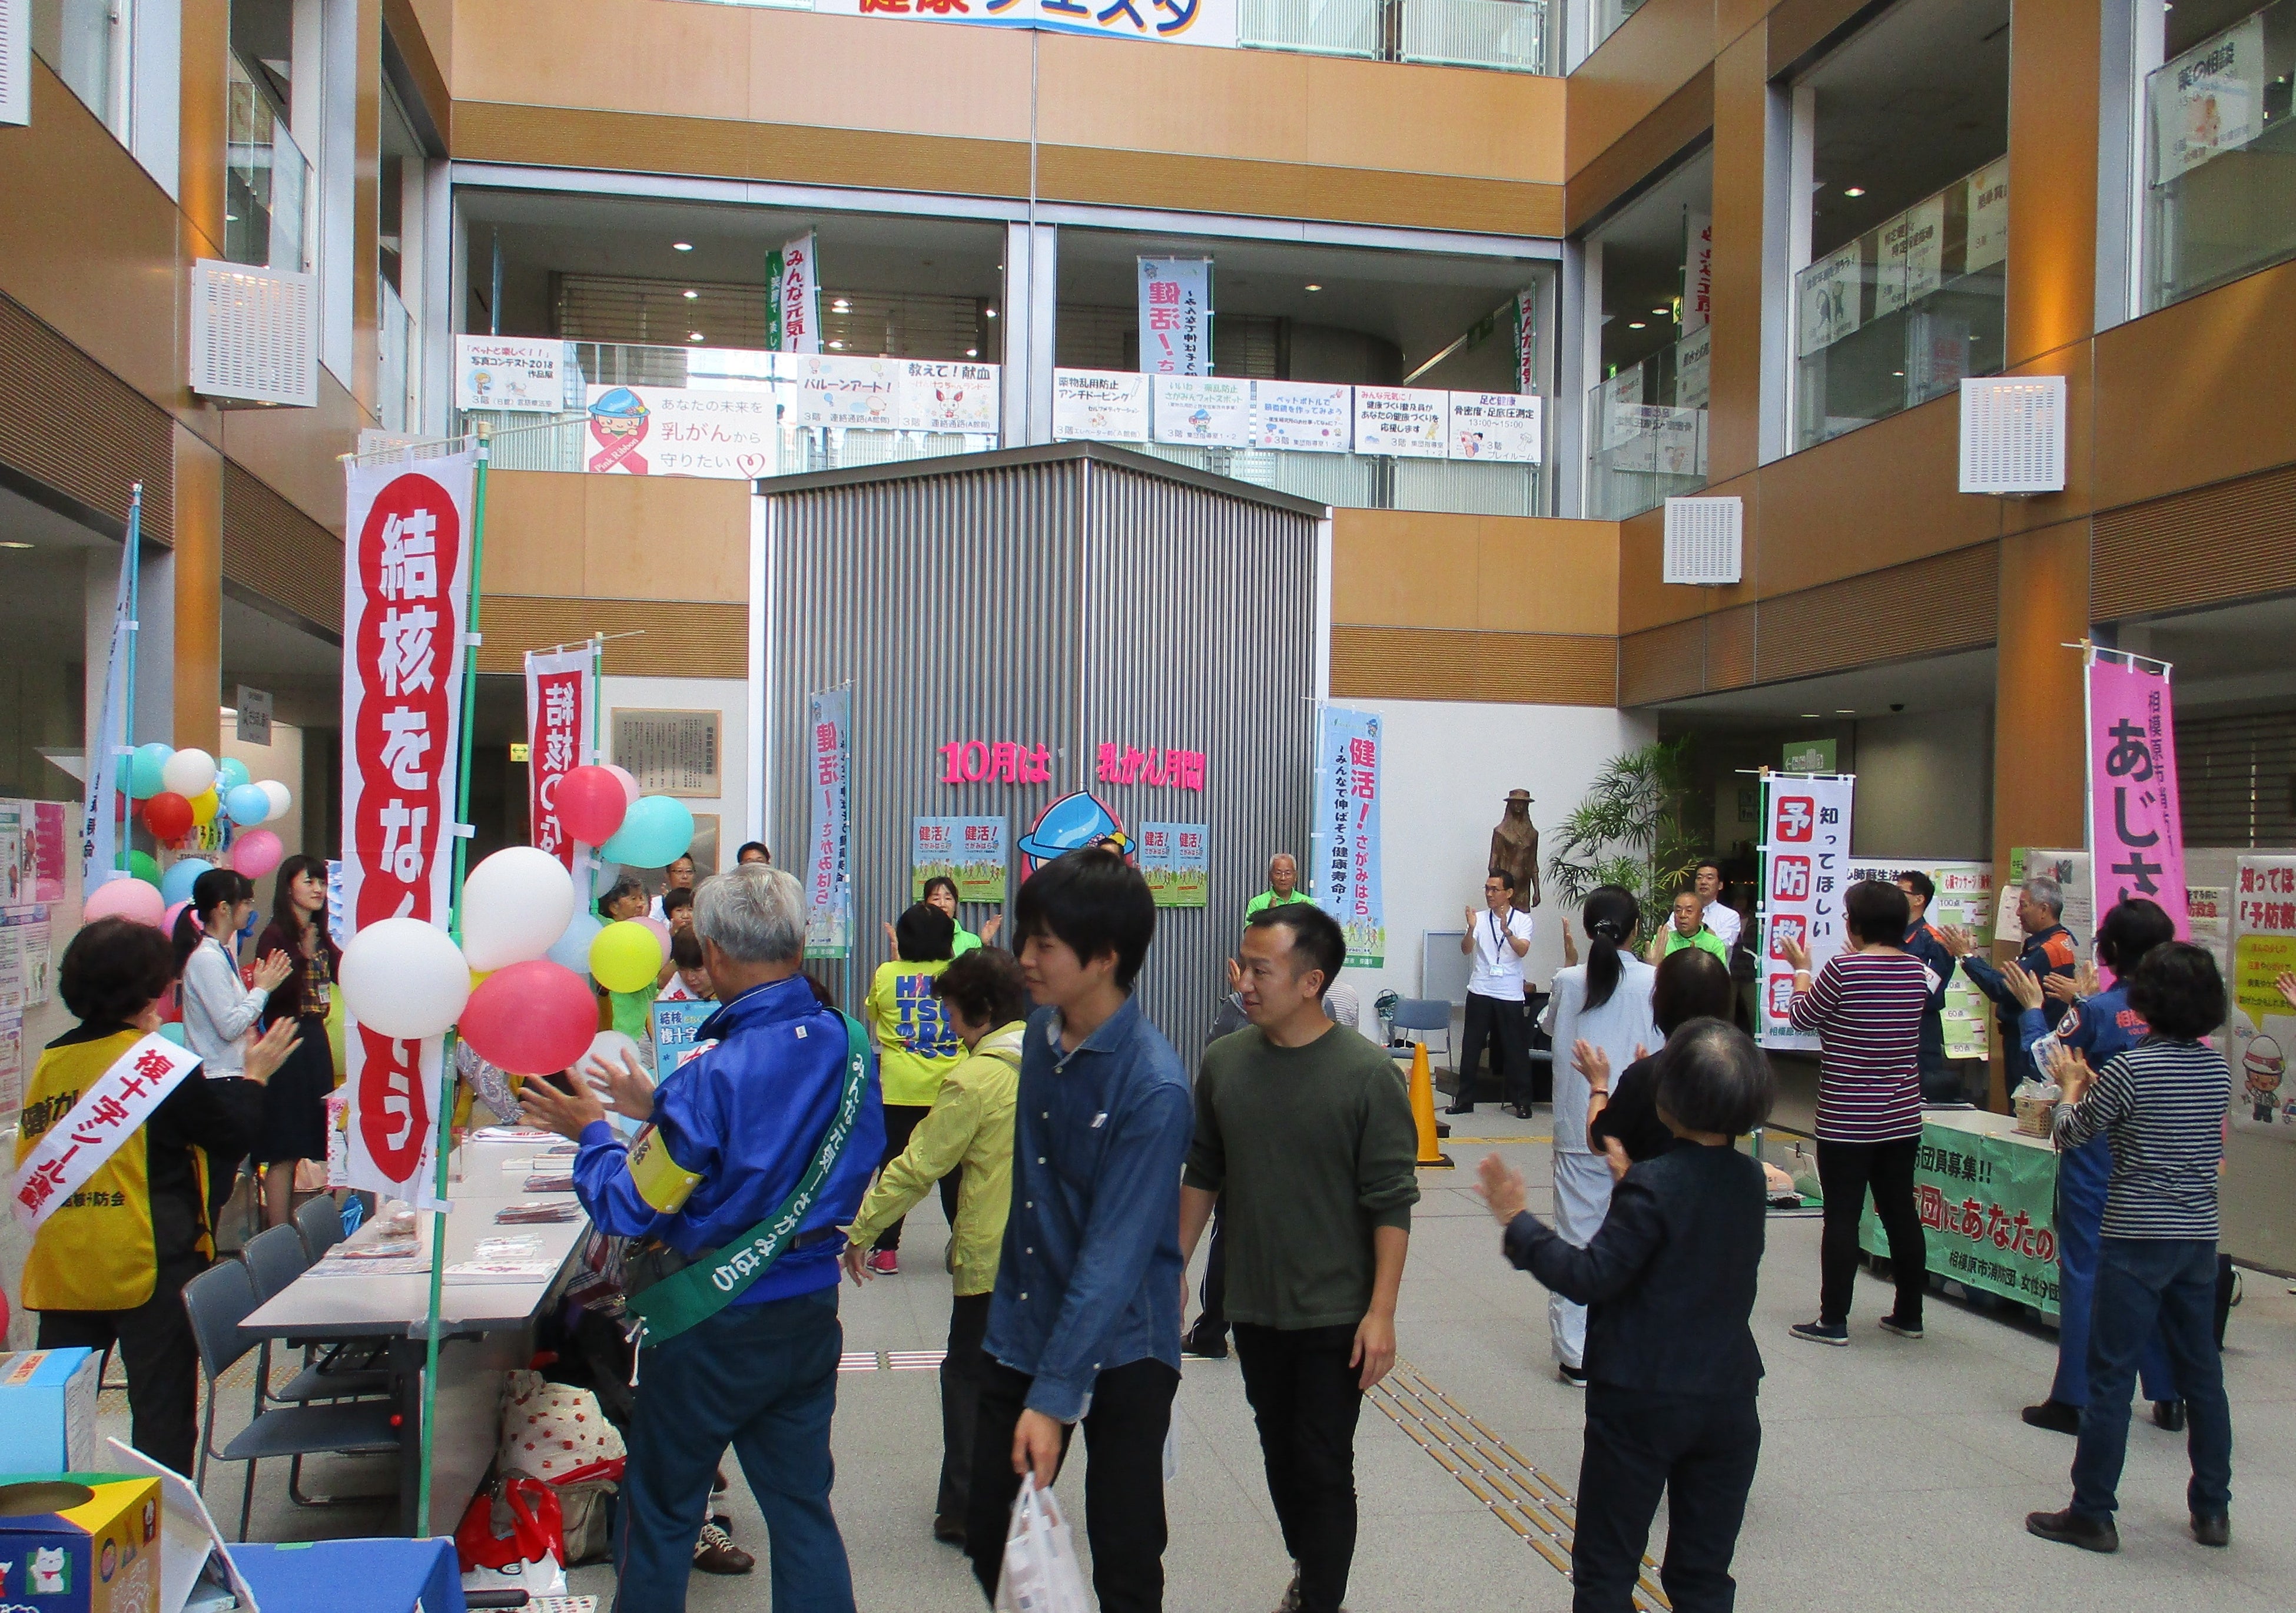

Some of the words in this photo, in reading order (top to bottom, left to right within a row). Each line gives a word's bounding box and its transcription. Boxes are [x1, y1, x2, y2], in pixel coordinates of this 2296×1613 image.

[471, 356, 553, 369] 写真コンテスト2018
[528, 370, 553, 379] 作品展
[908, 363, 990, 380] 教えて！献血
[804, 379, 891, 393] バルーンアート！
[1059, 377, 1119, 390] 薬物乱用防止
[1059, 390, 1129, 401] アンチドーピング
[1276, 397, 1331, 406] ペットボトルで
[1361, 391, 1412, 400] みんな元気に！
[1479, 394, 1516, 406] 足と健康
[661, 397, 763, 413] あなたの未来を
[1367, 400, 1433, 412] 健康づくり普及員が
[1454, 405, 1534, 419] 骨密度・足底圧測定
[804, 413, 821, 421] 3階
[903, 418, 920, 427] 3階
[1361, 411, 1439, 423] あなたの健康づくりを
[661, 421, 762, 444] 乳がんから
[1167, 429, 1183, 438] 3階
[1381, 423, 1420, 433] 応援します
[1274, 436, 1289, 444] 3階
[1391, 438, 1406, 447] 3階
[1487, 442, 1502, 450] 3階
[594, 457, 615, 473] Pink
[611, 438, 639, 459] Ribbon
[661, 452, 732, 469] 守りたい
[1488, 452, 1534, 460] プレイルーム
[939, 739, 1051, 784] 10月は
[1097, 742, 1206, 792] 乳がん月間
[377, 509, 437, 1150] 結核をなう
[919, 825, 950, 841] 健活！
[965, 825, 997, 841] 健活！
[1349, 736, 1376, 916] 健活！さがみはら
[1144, 831, 1169, 847] 健活！
[1179, 832, 1202, 848] 健活！
[1814, 806, 1839, 937] 知ってほしい
[660, 1027, 698, 1044] 複十字
[1913, 1183, 2061, 1264] 団にあなたの
[1949, 1249, 2016, 1289] 相模原市消防団
